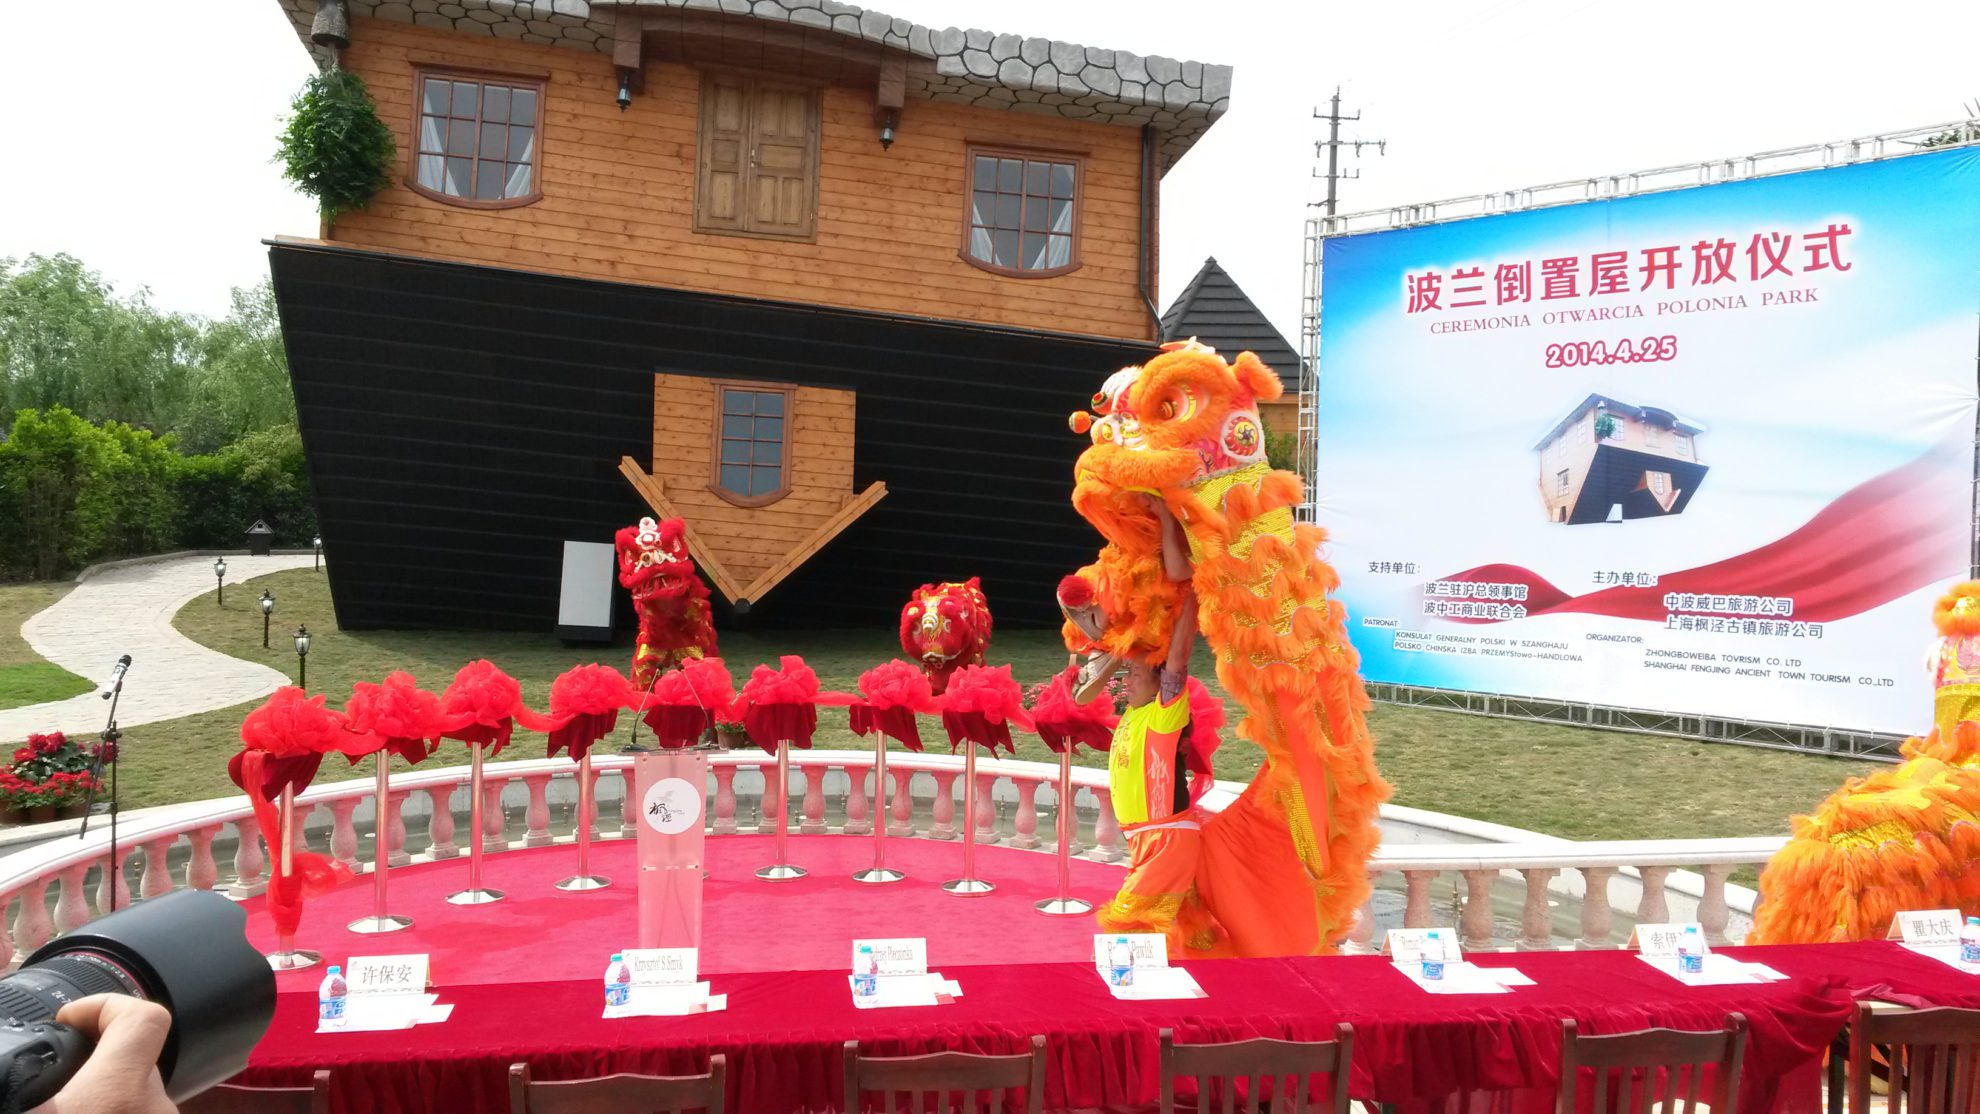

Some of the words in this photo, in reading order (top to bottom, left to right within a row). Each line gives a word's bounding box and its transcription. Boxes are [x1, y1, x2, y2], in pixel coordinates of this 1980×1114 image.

[1407, 224, 1852, 313] 波兰倒置屋开放仪式
[1430, 314, 1531, 334] CEREMONIA
[1542, 304, 1645, 325] OTWARCIA
[1656, 295, 1748, 318] POLONIA
[1761, 287, 1820, 306] PARK
[1545, 334, 1677, 368] 2014.4.25
[1425, 581, 1527, 600] 波兰驻沪总领事馆
[1424, 600, 1526, 620] 波中工商业联合会
[1664, 593, 1793, 615] 中波威巴旅游公司
[1663, 615, 1824, 640] 上海枫泾古镇旅游公司
[1394, 641, 1422, 651] POLSKO
[1460, 647, 1478, 655] IZBA
[1395, 631, 1433, 641] KONSULAT
[1435, 634, 1477, 645] GENERALNY
[1480, 637, 1506, 646] POLSKI
[1510, 639, 1518, 647] W
[1521, 640, 1569, 651] SZANGHAJU
[1585, 633, 1644, 645] ORGANIZATOR:
[1645, 648, 1717, 662] ZHONGBOWEIBA
[1785, 658, 1802, 668] LTD
[1643, 660, 1687, 672] SHANGHAI
[1690, 664, 1731, 675] FENGJING
[1735, 667, 1771, 678] ANCIENT
[1778, 670, 1806, 680] TOWN
[1810, 673, 1851, 684] TOURISM
[362, 963, 413, 985] 许保安
